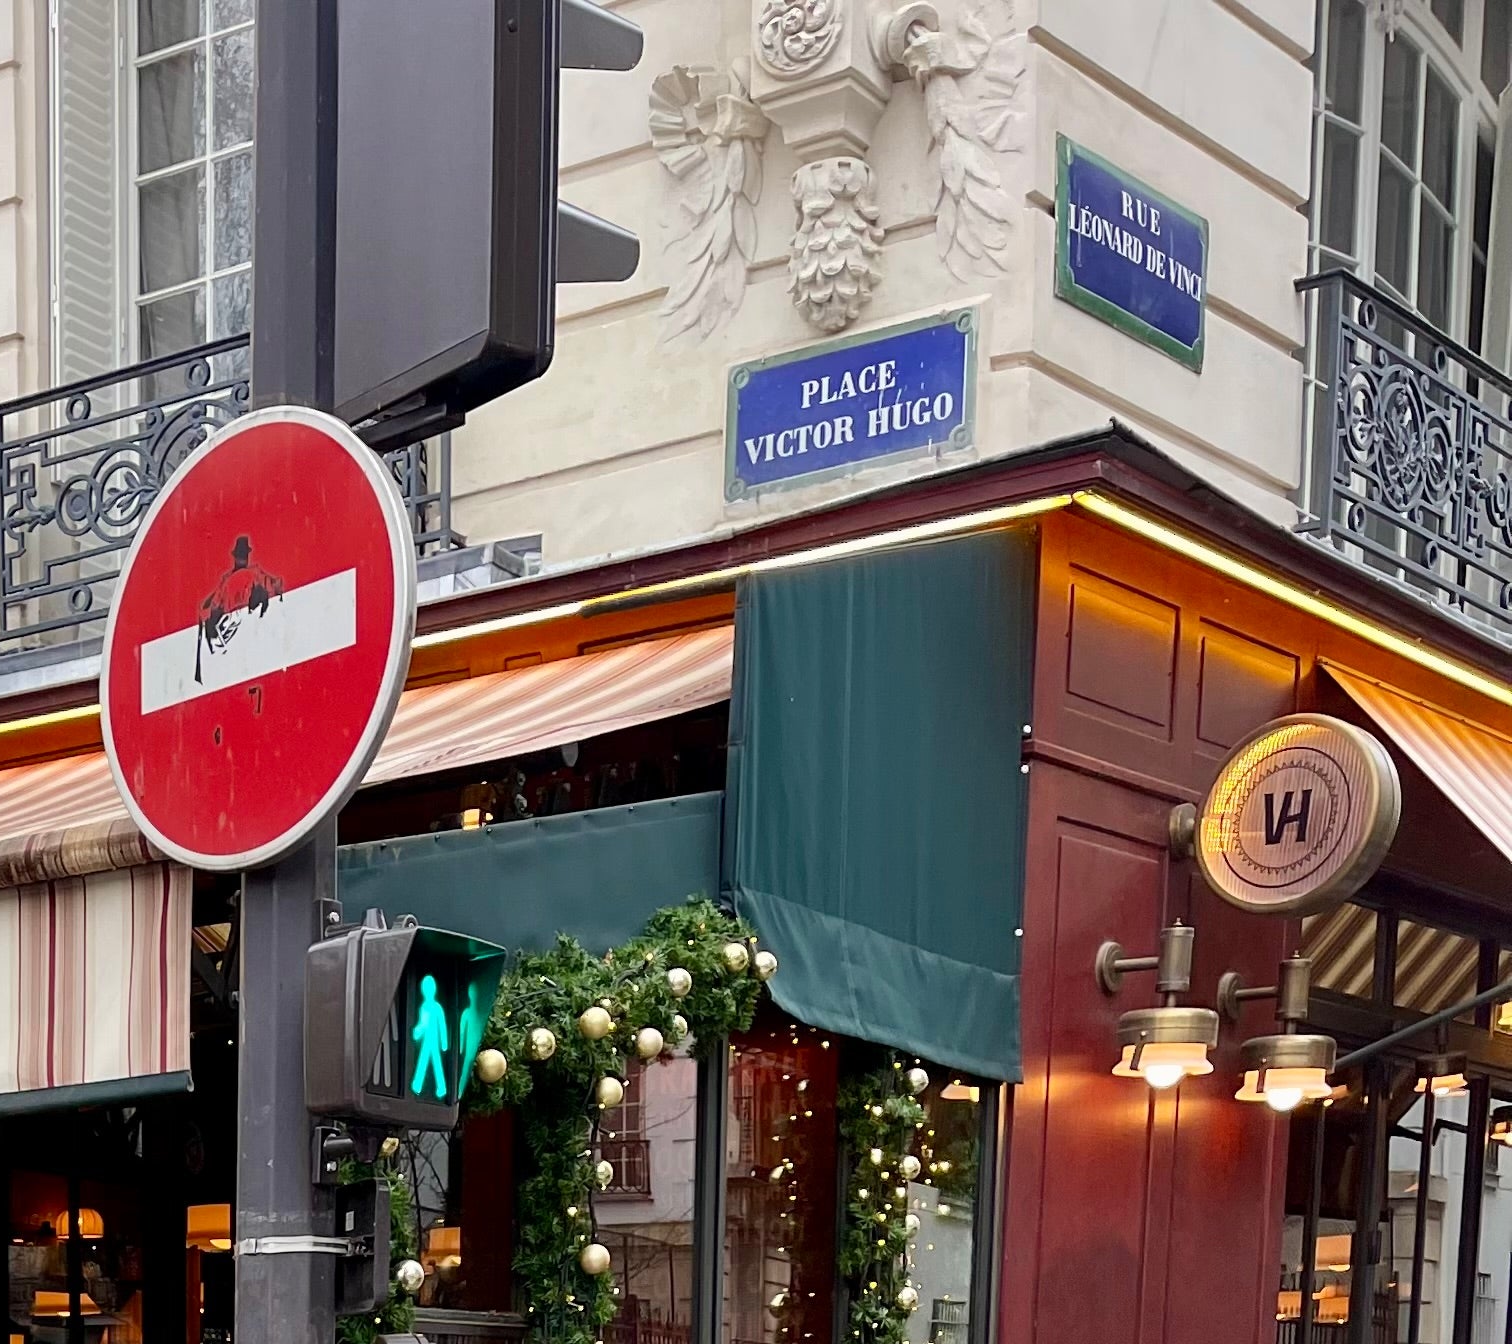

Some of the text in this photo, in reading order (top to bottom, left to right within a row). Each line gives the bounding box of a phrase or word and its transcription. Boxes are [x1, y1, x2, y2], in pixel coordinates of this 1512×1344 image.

[1121, 190, 1161, 236] RUE
[1069, 203, 1202, 302] LÉONARD DE VINCI
[801, 360, 897, 409] PLACE
[744, 392, 954, 465] VICTOR HUGO
[1264, 788, 1313, 846] VH
